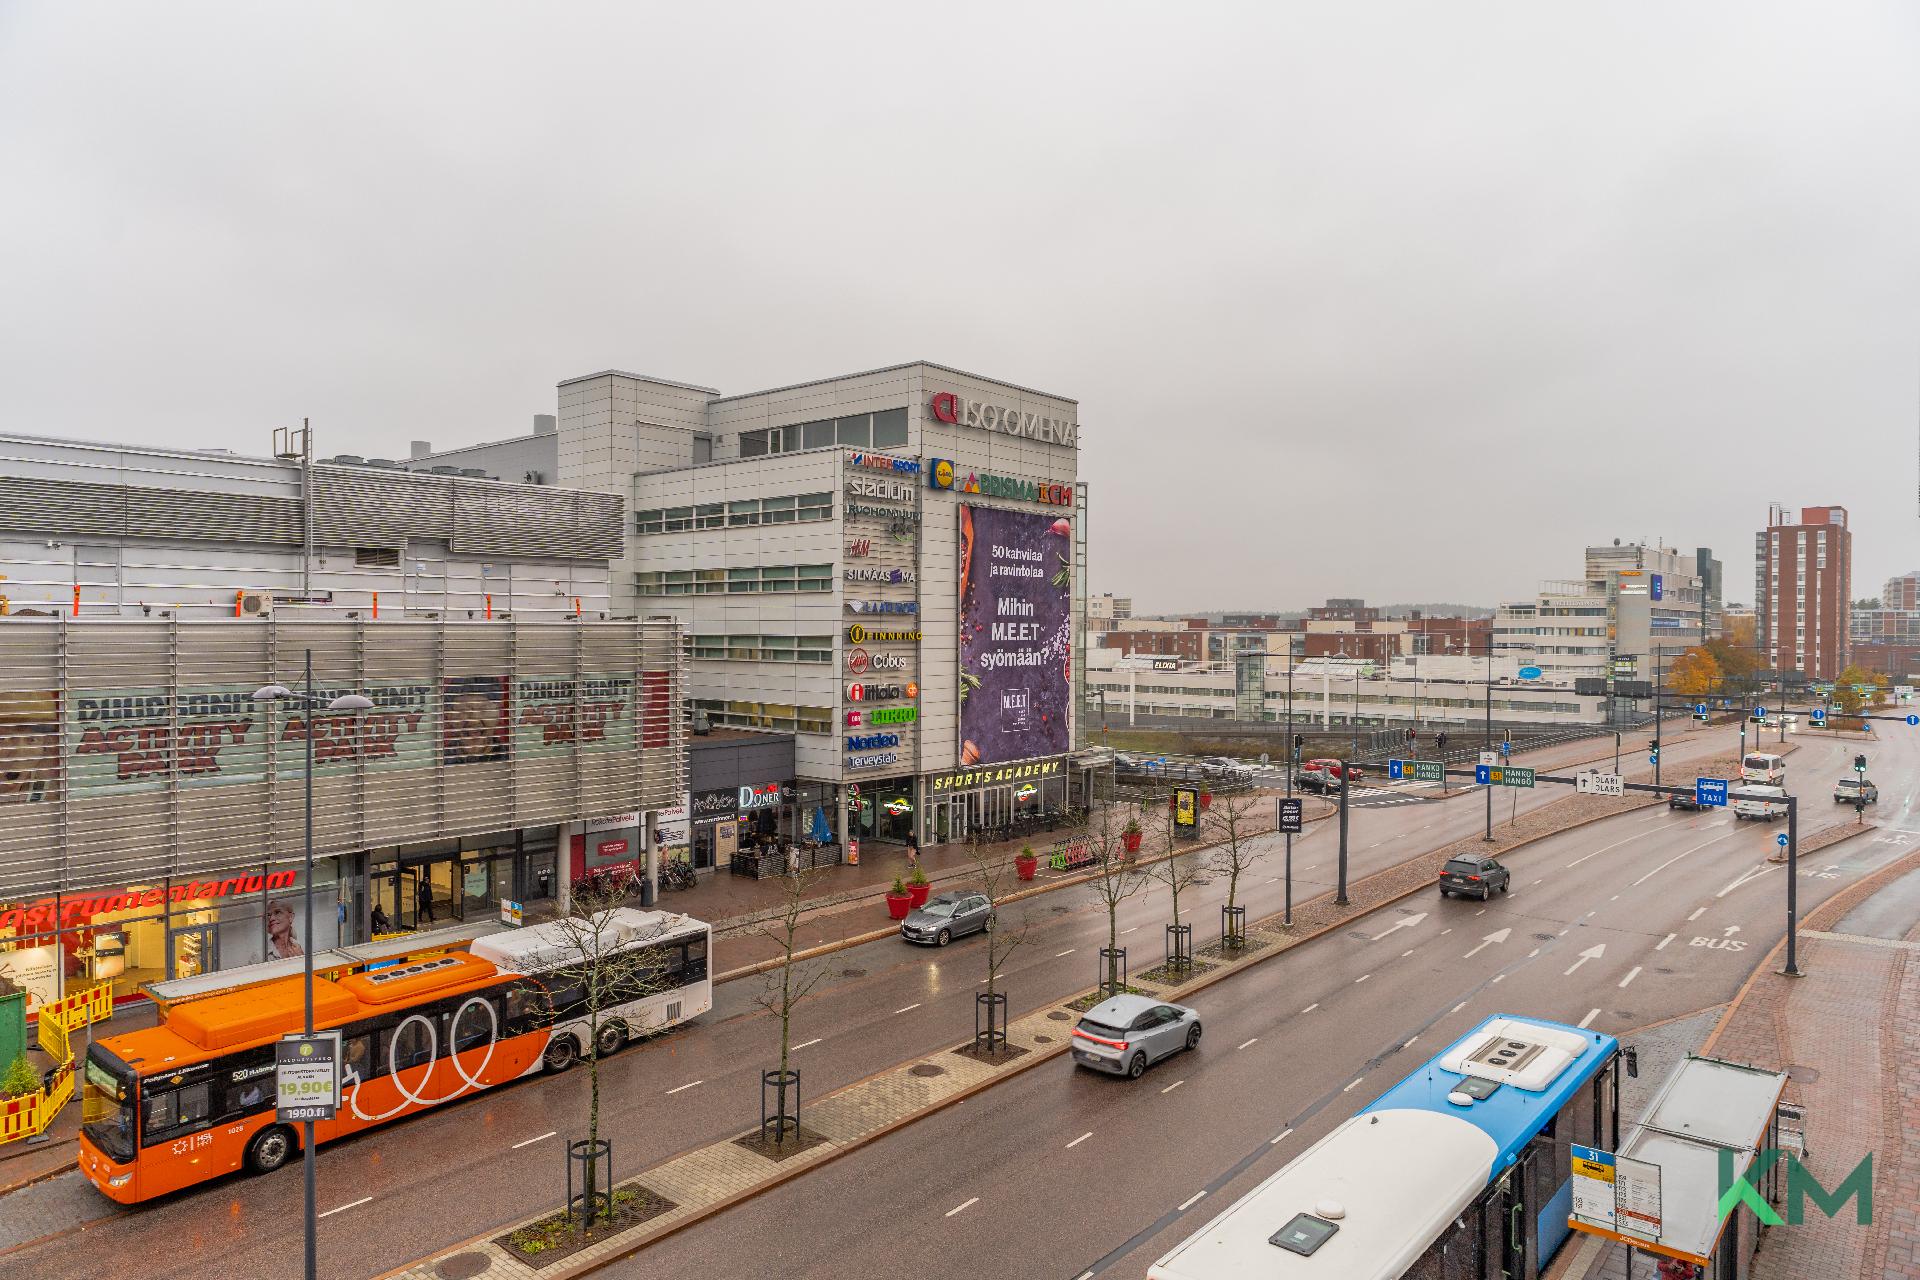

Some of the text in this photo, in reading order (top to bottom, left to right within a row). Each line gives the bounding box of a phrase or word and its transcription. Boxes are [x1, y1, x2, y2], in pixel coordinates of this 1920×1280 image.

[963, 399, 998, 431] ISO
[1003, 407, 1077, 448] OMENA
[849, 477, 914, 501] stadium
[980, 473, 1037, 503] PRISMA
[991, 544, 1043, 562] 50 kahvilaa
[989, 562, 1044, 578] ja ravintolaa
[997, 597, 1034, 617] Mihin
[980, 647, 1050, 671] syömään?
[847, 733, 900, 751] Nordea
[849, 752, 898, 768] Terveystalo
[933, 761, 1060, 790] SPORTS ACADEMY
[1505, 769, 1532, 778] HANKO
[1702, 793, 1722, 803] TAXI
[1688, 936, 1749, 952] BUS
[232, 1068, 249, 1082] 520
[286, 1107, 325, 1119] 1990.fi
[1588, 1150, 1599, 1162] 31
